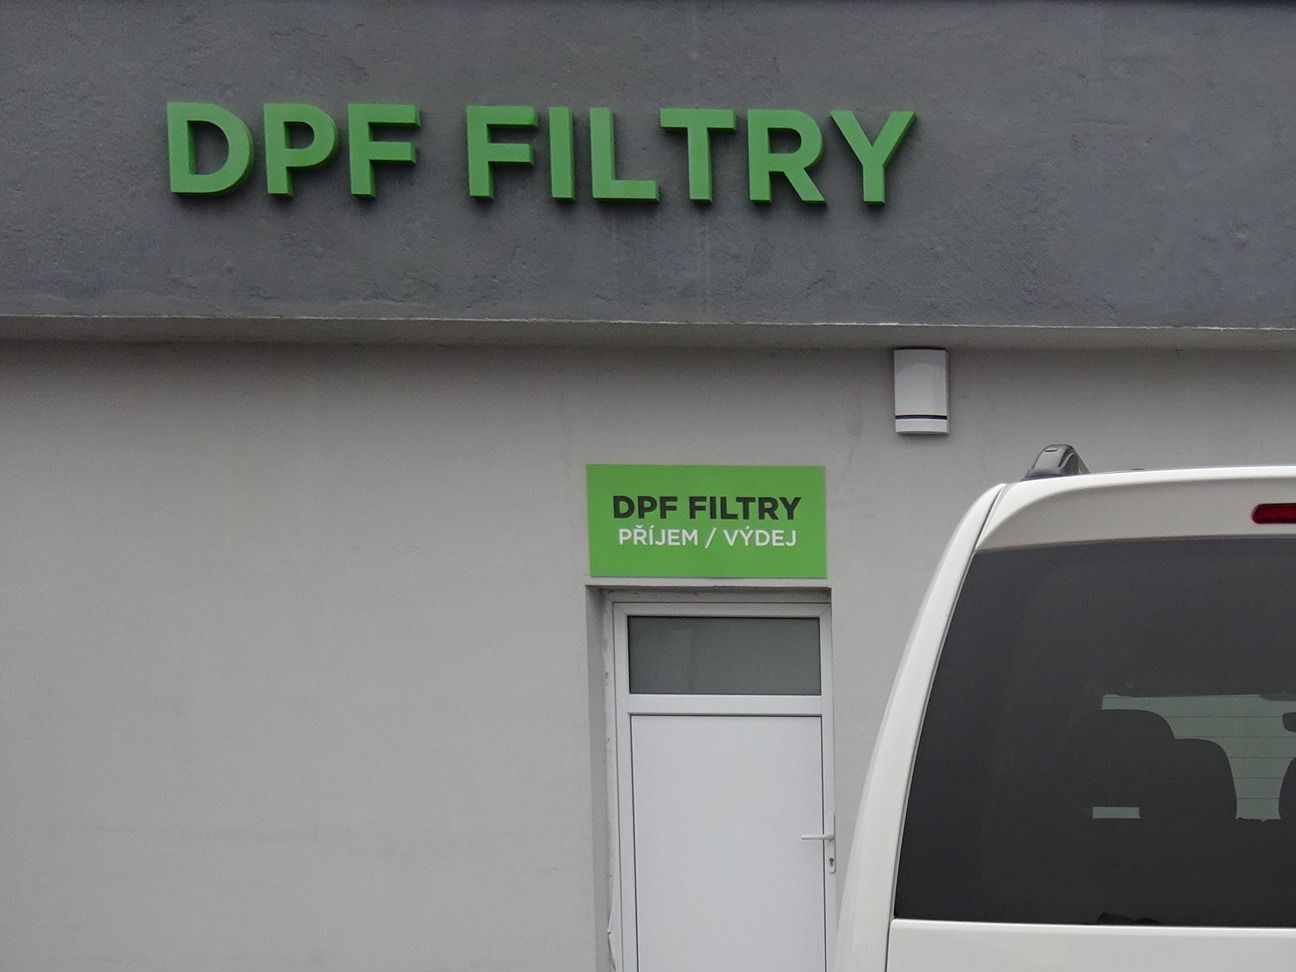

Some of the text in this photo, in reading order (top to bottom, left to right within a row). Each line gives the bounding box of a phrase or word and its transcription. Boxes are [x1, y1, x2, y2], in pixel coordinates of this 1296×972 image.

[167, 102, 916, 205] DPF FILTRY
[612, 495, 801, 520] DPF FILTRY
[619, 524, 796, 549] PŘÍJEM / VÝDEJ
